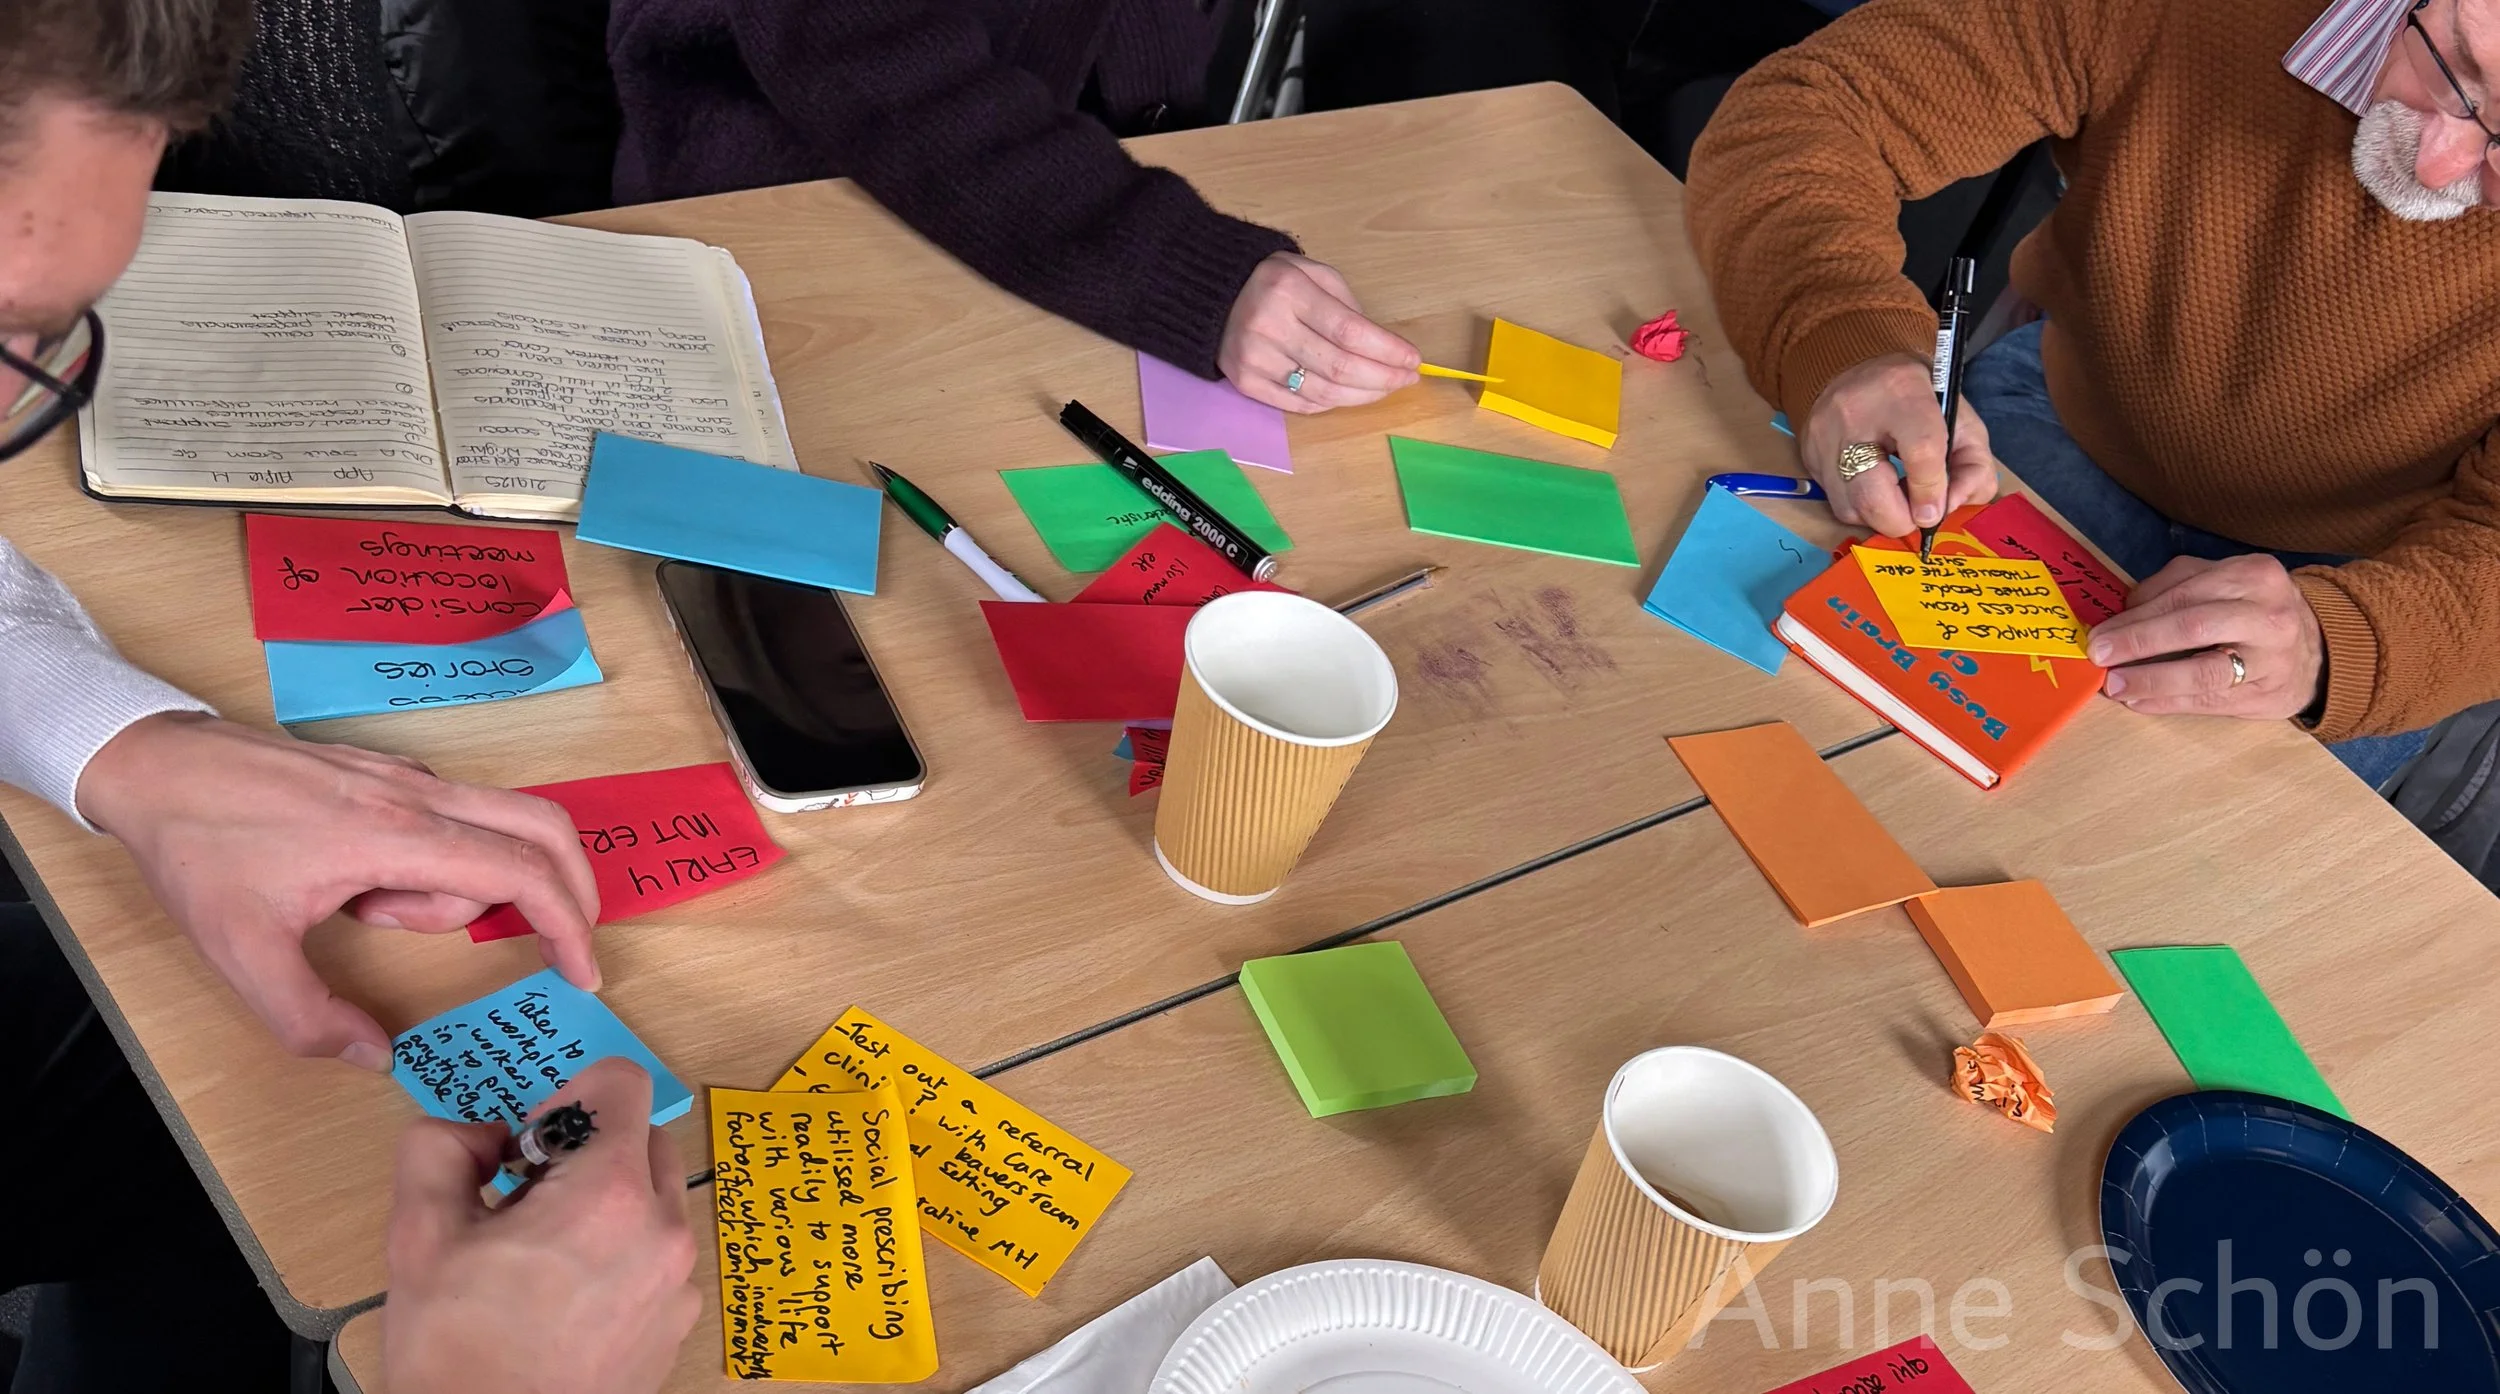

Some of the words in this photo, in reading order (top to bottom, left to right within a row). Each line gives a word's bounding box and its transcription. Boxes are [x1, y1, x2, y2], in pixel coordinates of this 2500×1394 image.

[226, 449, 283, 460] from
[334, 468, 373, 483] App
[359, 531, 535, 564] meetings
[1141, 476, 1191, 524] edding
[1190, 513, 1227, 550] 2000
[1226, 542, 1239, 559] C
[276, 557, 320, 591] of
[340, 567, 511, 593] location
[1826, 595, 1918, 672] Brain
[1927, 670, 2009, 741] Busy
[627, 845, 759, 897] EARLY
[487, 1008, 572, 1090] workplac
[558, 1039, 585, 1059] to
[759, 1111, 790, 1168] with
[790, 1112, 827, 1203] readily
[861, 1110, 898, 1189] Social
[902, 1063, 950, 1090] out
[960, 1098, 978, 1115] a
[996, 1119, 1096, 1183] referral
[938, 1115, 988, 1153] with
[826, 1111, 864, 1207] utilised
[740, 1201, 774, 1274] which
[769, 1187, 797, 1277] various
[807, 1222, 832, 1240] to
[841, 1222, 865, 1291] more
[988, 1239, 1039, 1271] MH
[791, 1259, 845, 1356] support
[860, 1206, 910, 1340] prescribing
[777, 1297, 809, 1349] life
